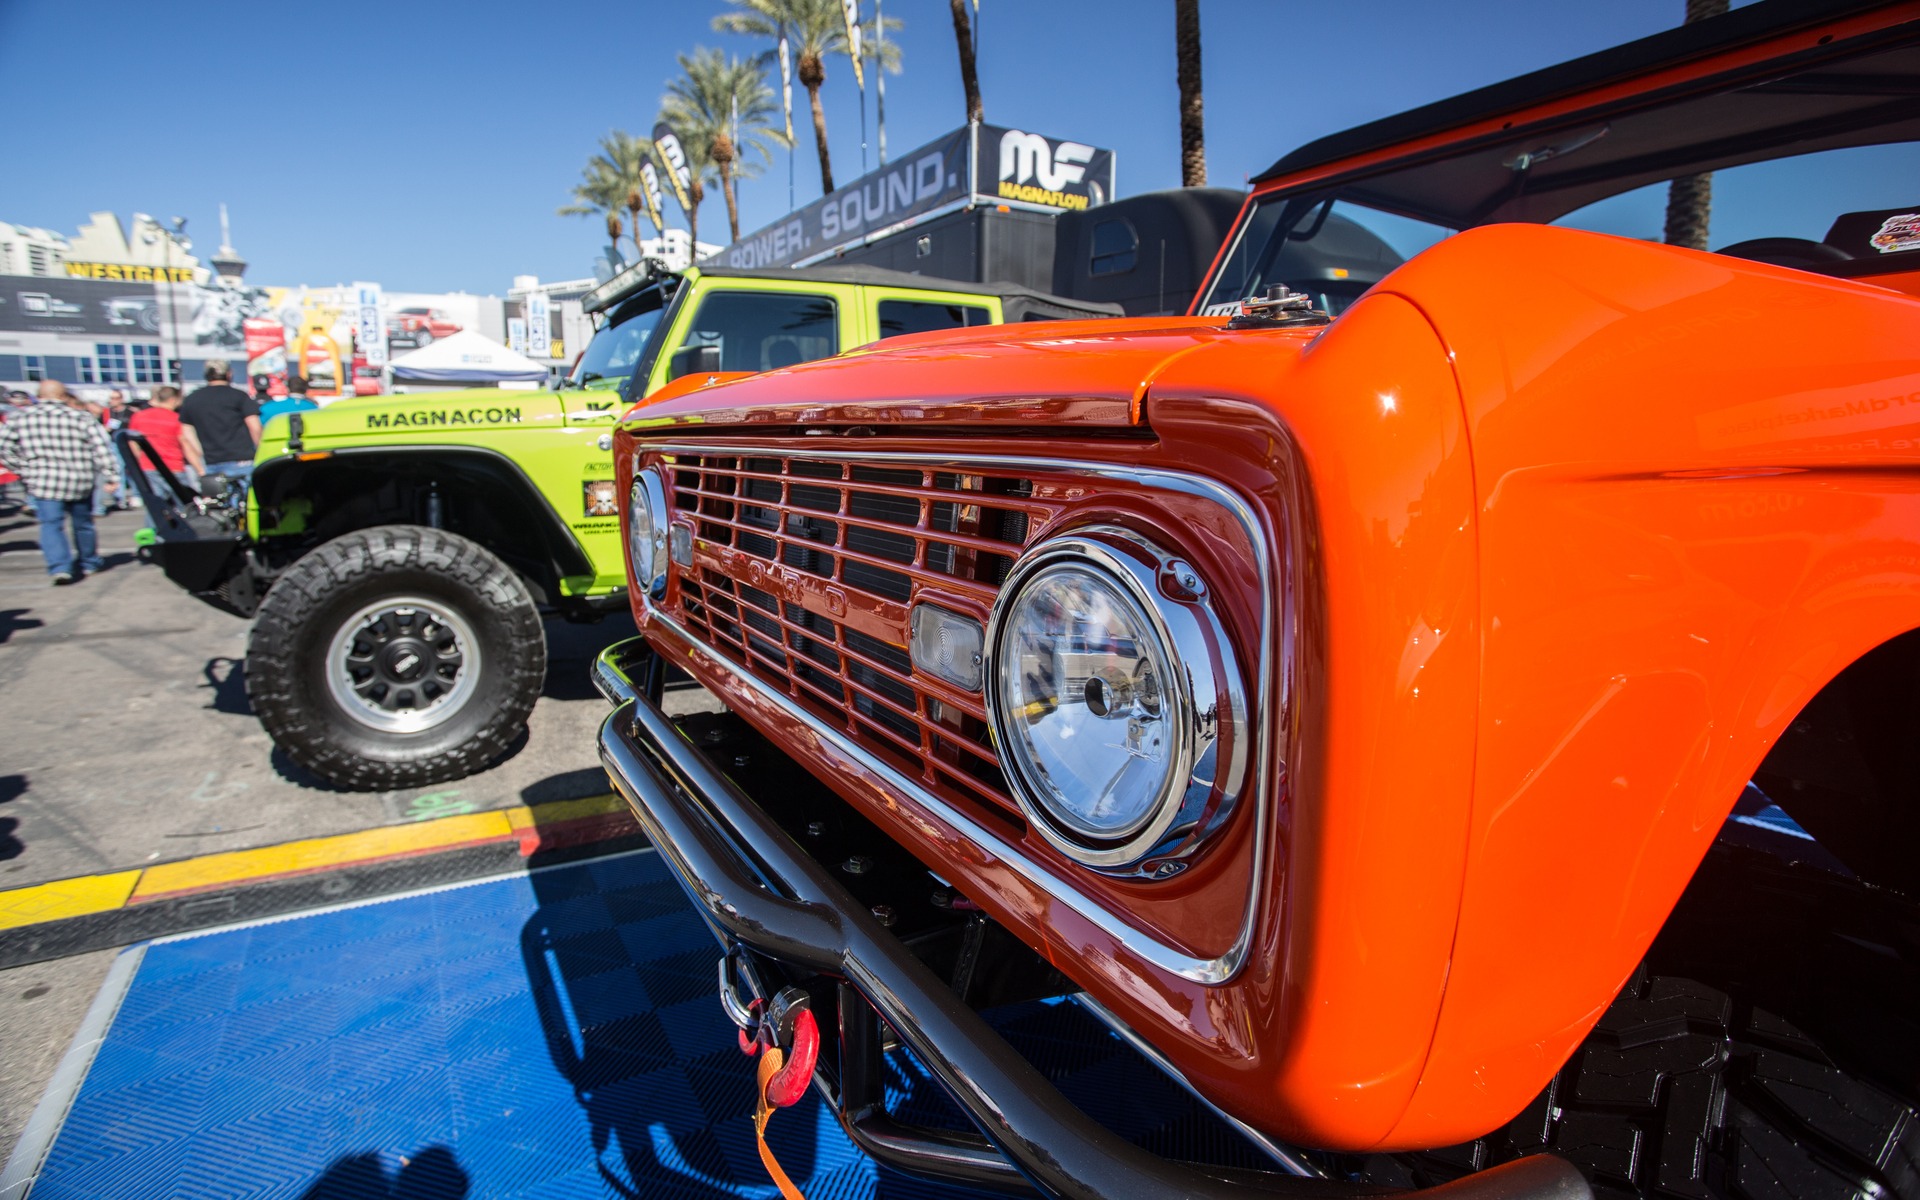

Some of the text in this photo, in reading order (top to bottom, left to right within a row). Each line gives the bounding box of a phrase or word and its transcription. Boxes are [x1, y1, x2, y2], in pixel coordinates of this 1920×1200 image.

[820, 151, 958, 241] SOUND.
[998, 181, 1089, 211] MAGNAFLOW
[65, 261, 193, 283] WESTGATE
[368, 407, 522, 428] MAGNACON
